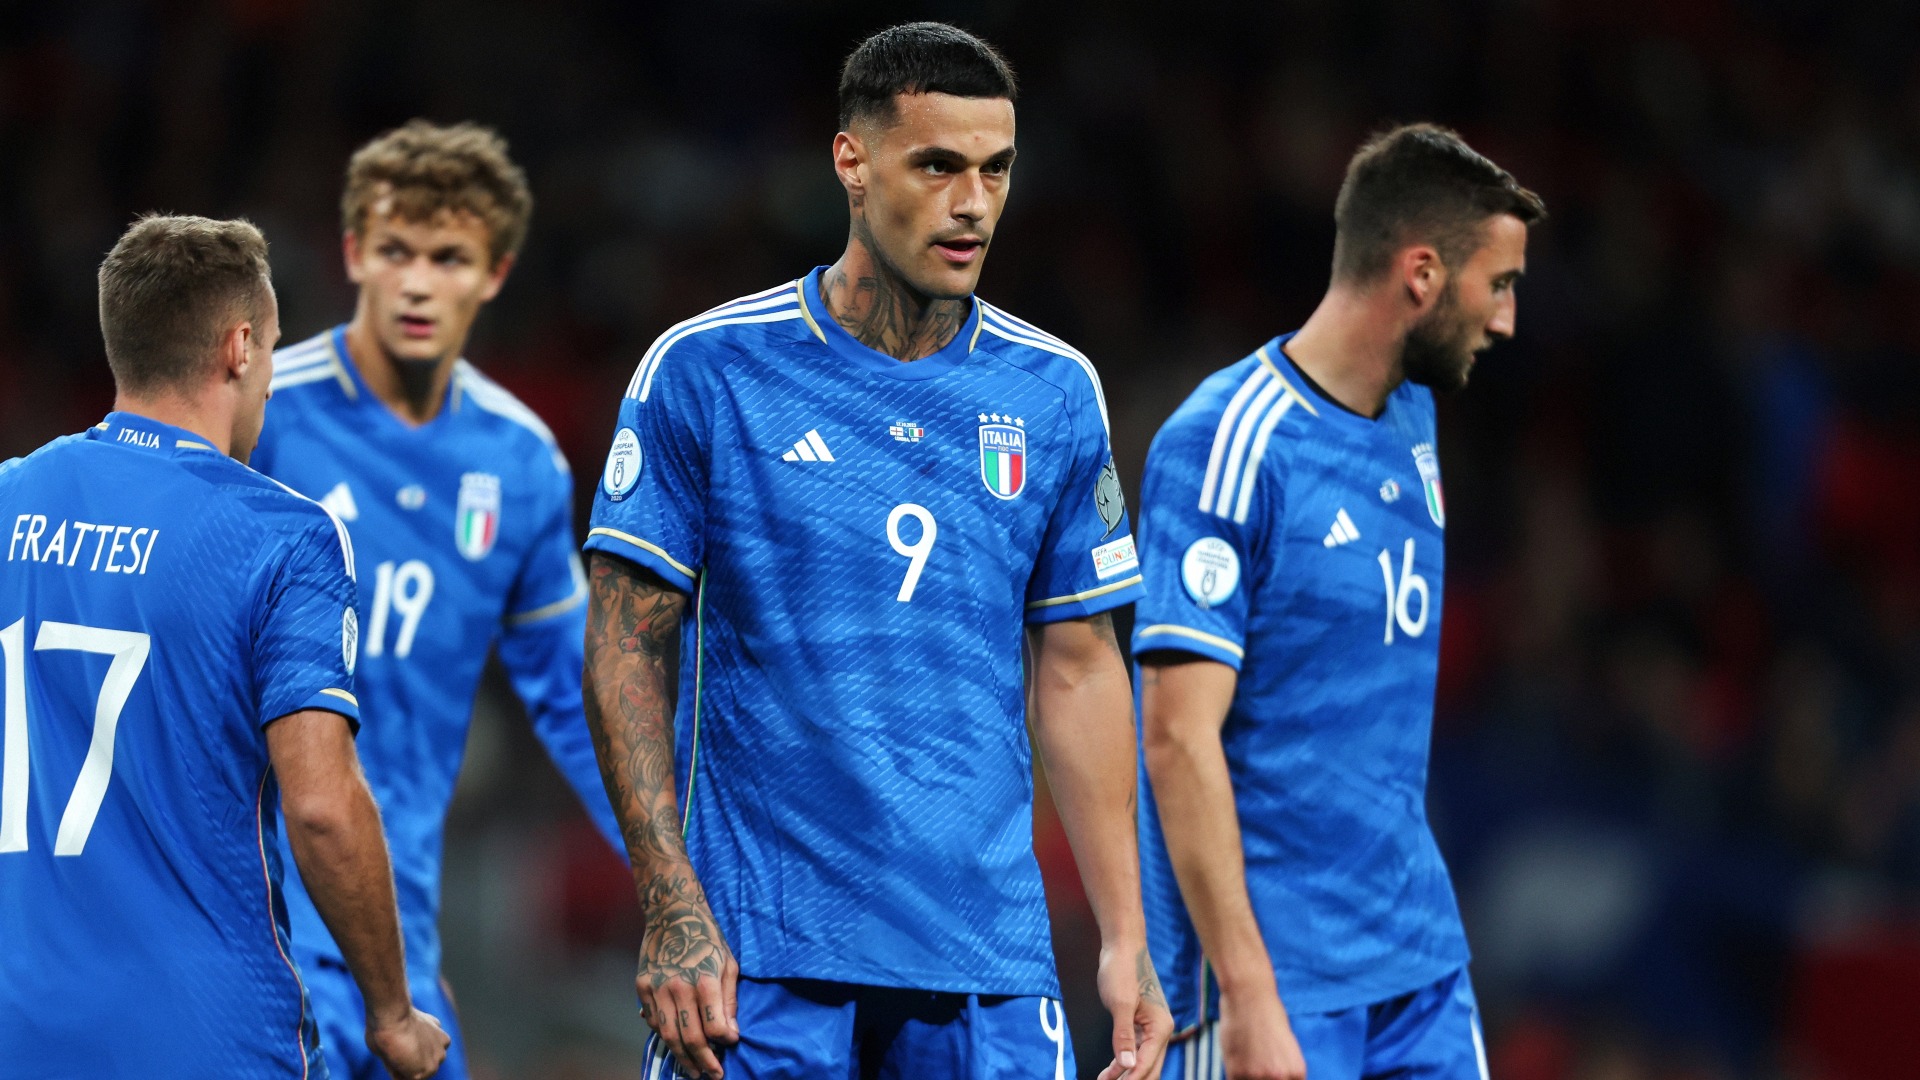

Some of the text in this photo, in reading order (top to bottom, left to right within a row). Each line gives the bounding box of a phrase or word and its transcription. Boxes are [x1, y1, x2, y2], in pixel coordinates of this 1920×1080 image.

[117, 428, 160, 449] ITALIA
[983, 430, 1022, 448] ITALIA
[8, 514, 159, 574] FRATTESI
[886, 503, 937, 602] 9
[365, 560, 434, 658] 19
[1377, 537, 1429, 646] 16
[0, 616, 151, 856] 17
[1039, 997, 1065, 1080] 9
